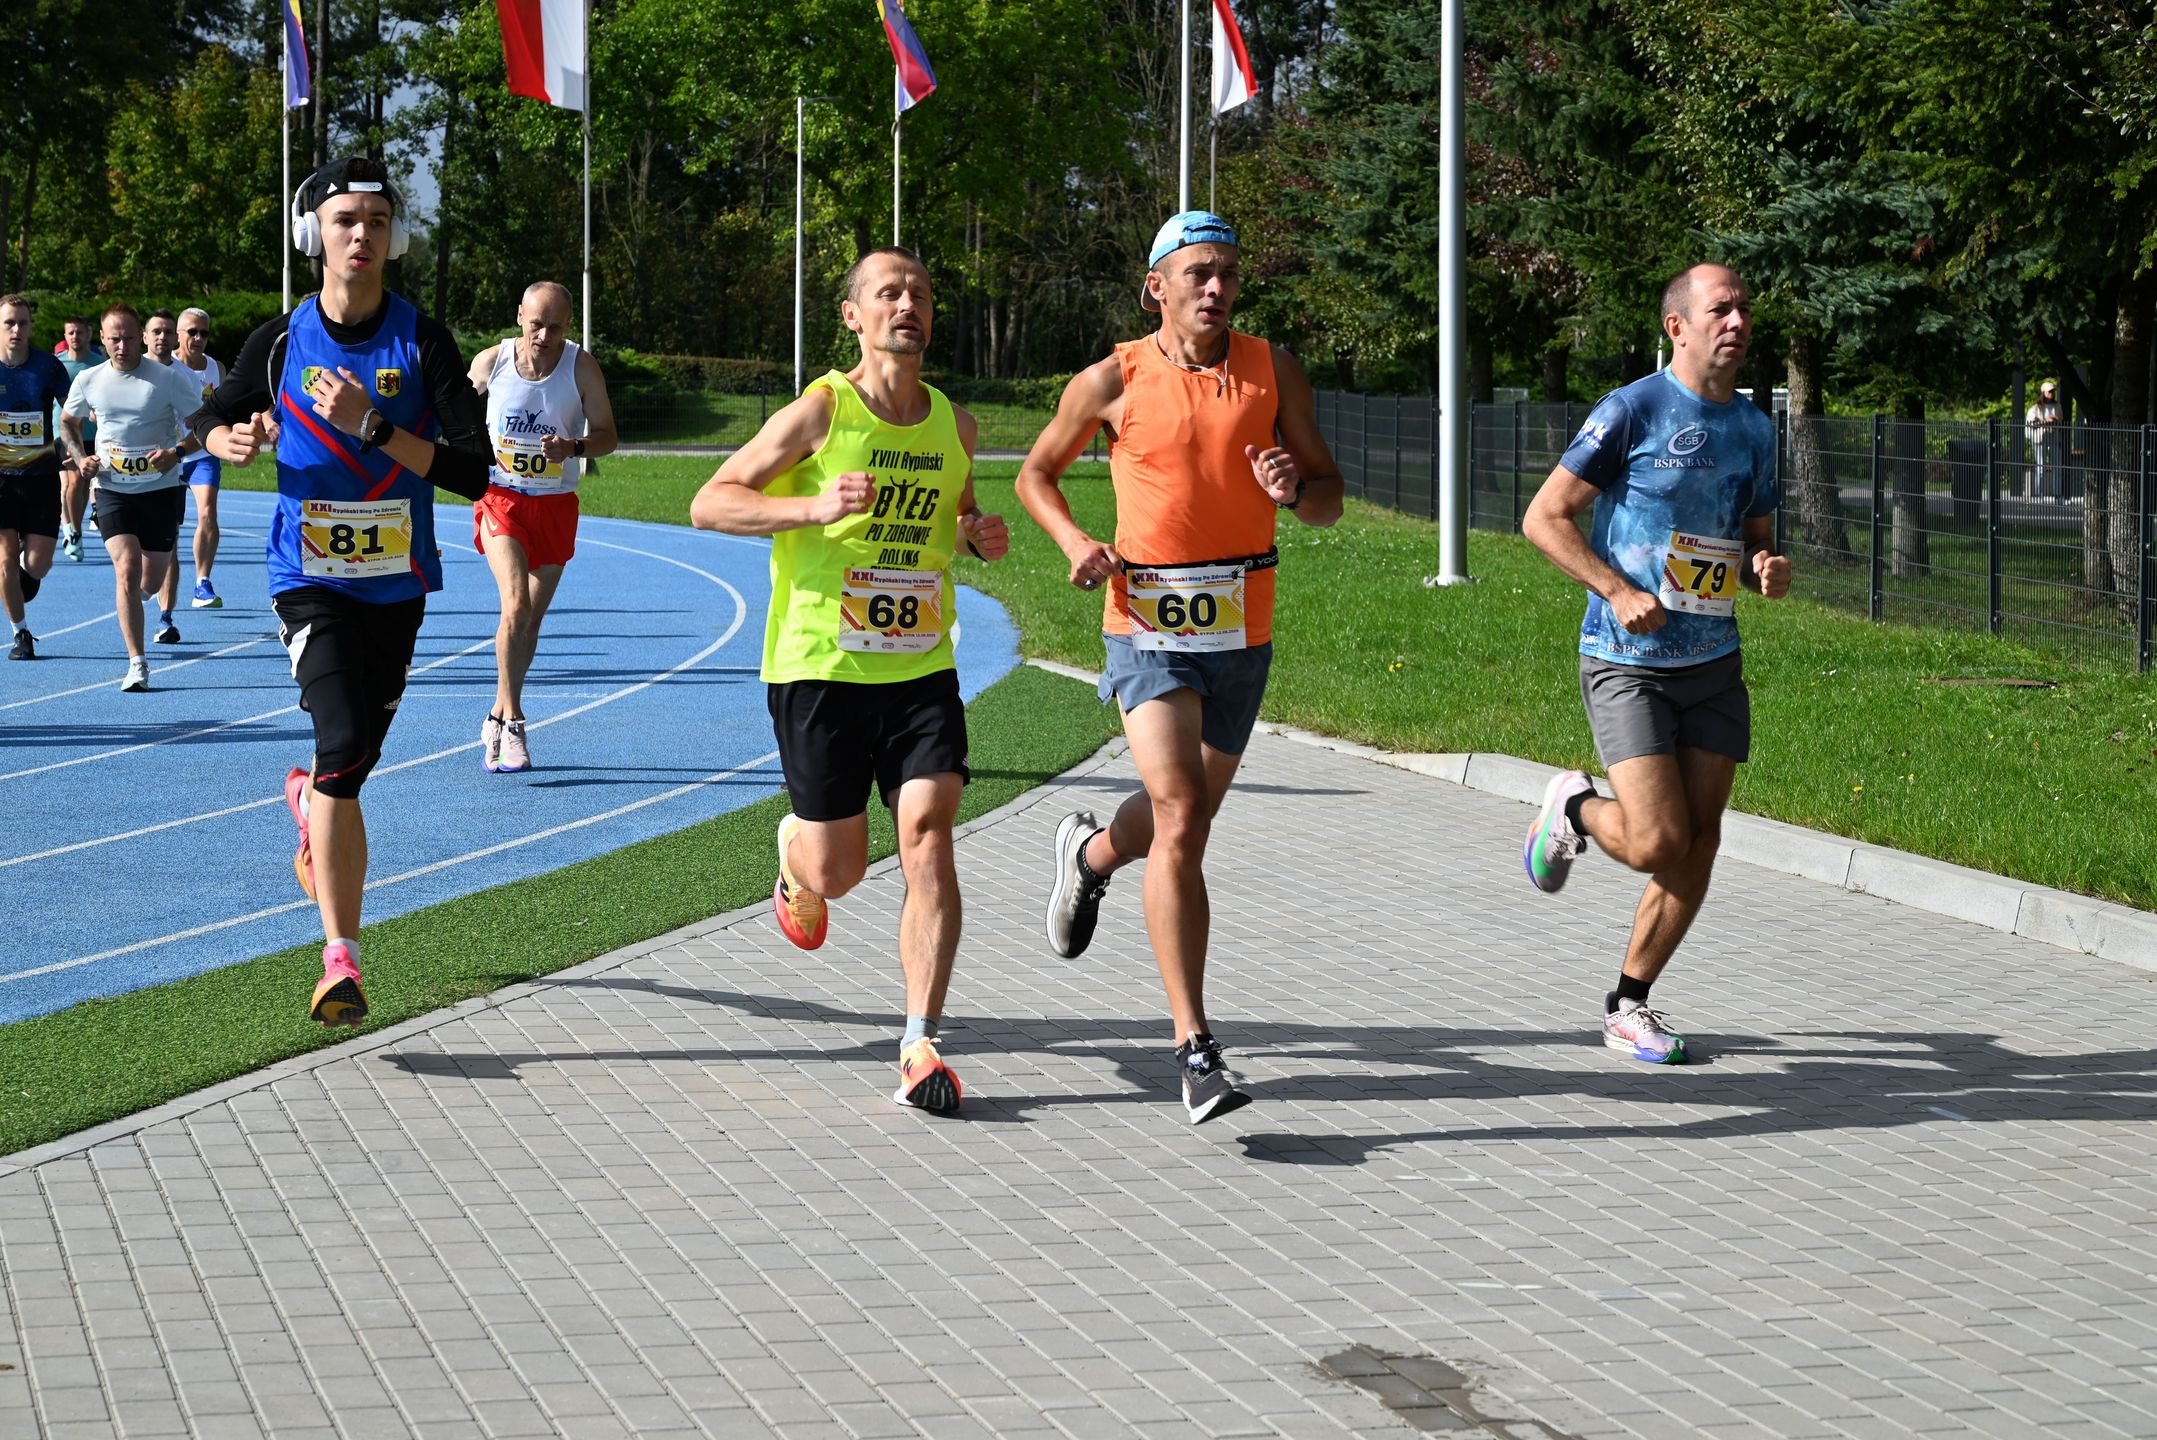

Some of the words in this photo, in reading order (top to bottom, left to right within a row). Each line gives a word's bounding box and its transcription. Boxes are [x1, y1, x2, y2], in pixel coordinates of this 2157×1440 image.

[8, 422, 31, 436] 18
[505, 415, 557, 435] Fitness
[503, 438, 516, 446] XXI
[1677, 436, 1700, 446] SGB
[121, 457, 149, 473] 40
[512, 452, 547, 474] 50
[868, 449, 900, 469] XVIII
[900, 451, 944, 472] Rypiński
[1654, 458, 1685, 468] BSPK
[1687, 457, 1715, 468] BANK
[310, 503, 332, 513] XXI
[328, 524, 384, 555] 81
[865, 523, 885, 541] PO
[882, 524, 932, 546] ZDROWIE
[1678, 536, 1699, 547] XXI
[851, 571, 874, 582] XXI
[1136, 573, 1159, 583] XXI
[1690, 558, 1727, 593] 79
[868, 594, 919, 629] 68
[1156, 592, 1217, 628] 60
[1607, 641, 1640, 656] BSPK
[1644, 646, 1683, 658] BANK
